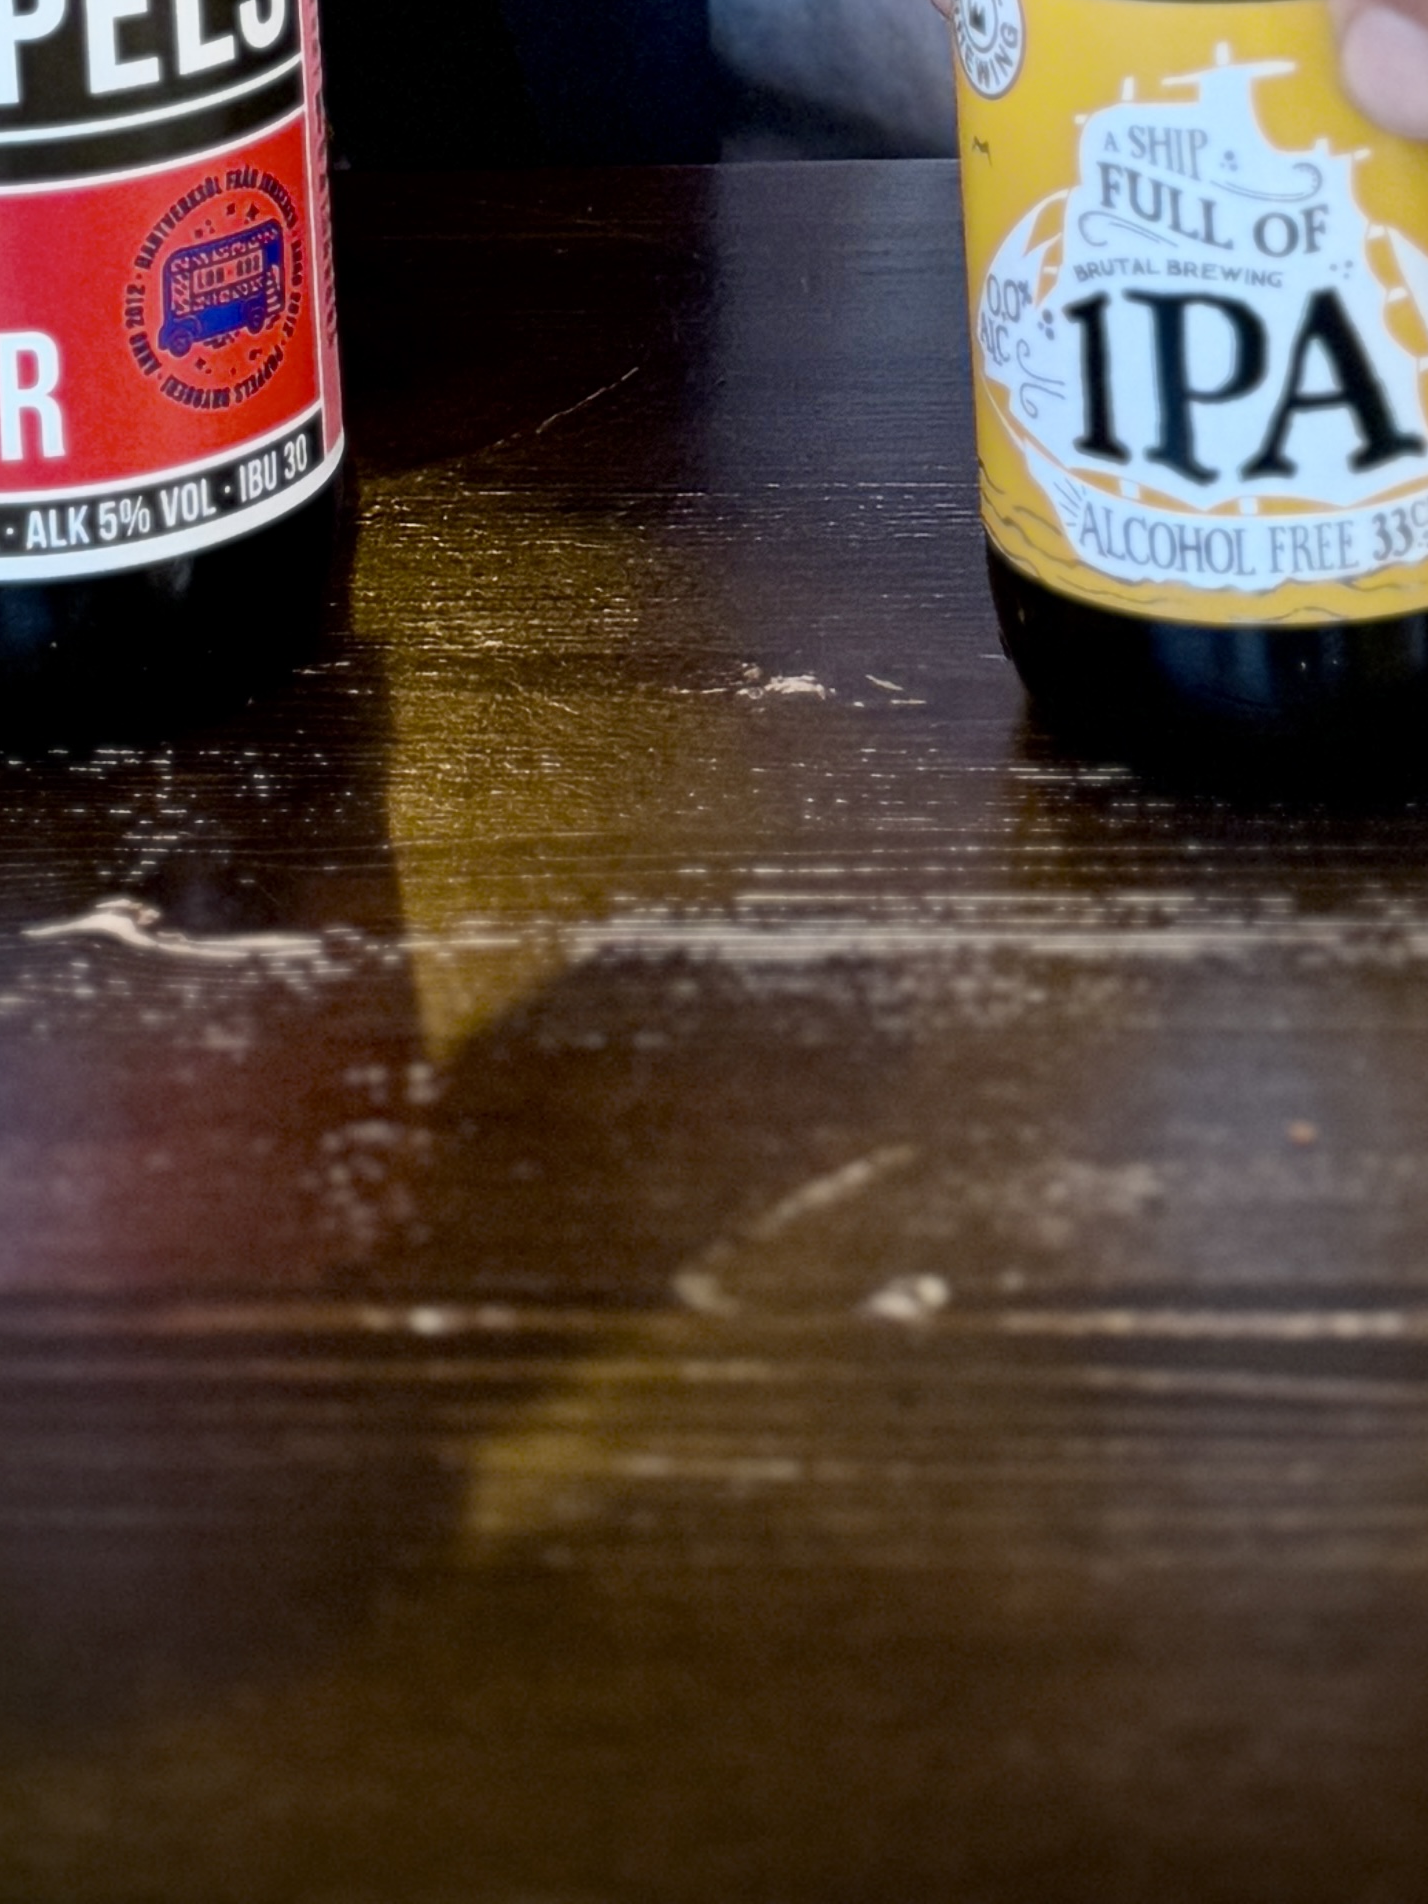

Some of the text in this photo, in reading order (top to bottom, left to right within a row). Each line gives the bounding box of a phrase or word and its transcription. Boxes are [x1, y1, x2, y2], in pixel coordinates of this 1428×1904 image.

[1104, 124, 1208, 182] A SHIP
[1096, 160, 1330, 258] FULL OF
[1073, 257, 1284, 288] BRUTAL BREWING
[1062, 284, 1428, 488] IPA
[25, 505, 91, 549] ALK
[98, 496, 151, 541] 5%
[161, 480, 217, 528] VOL
[238, 459, 278, 503] IBU
[283, 433, 308, 479] 30
[1079, 500, 1257, 577] ALCOHOL
[1269, 520, 1360, 574] FREE
